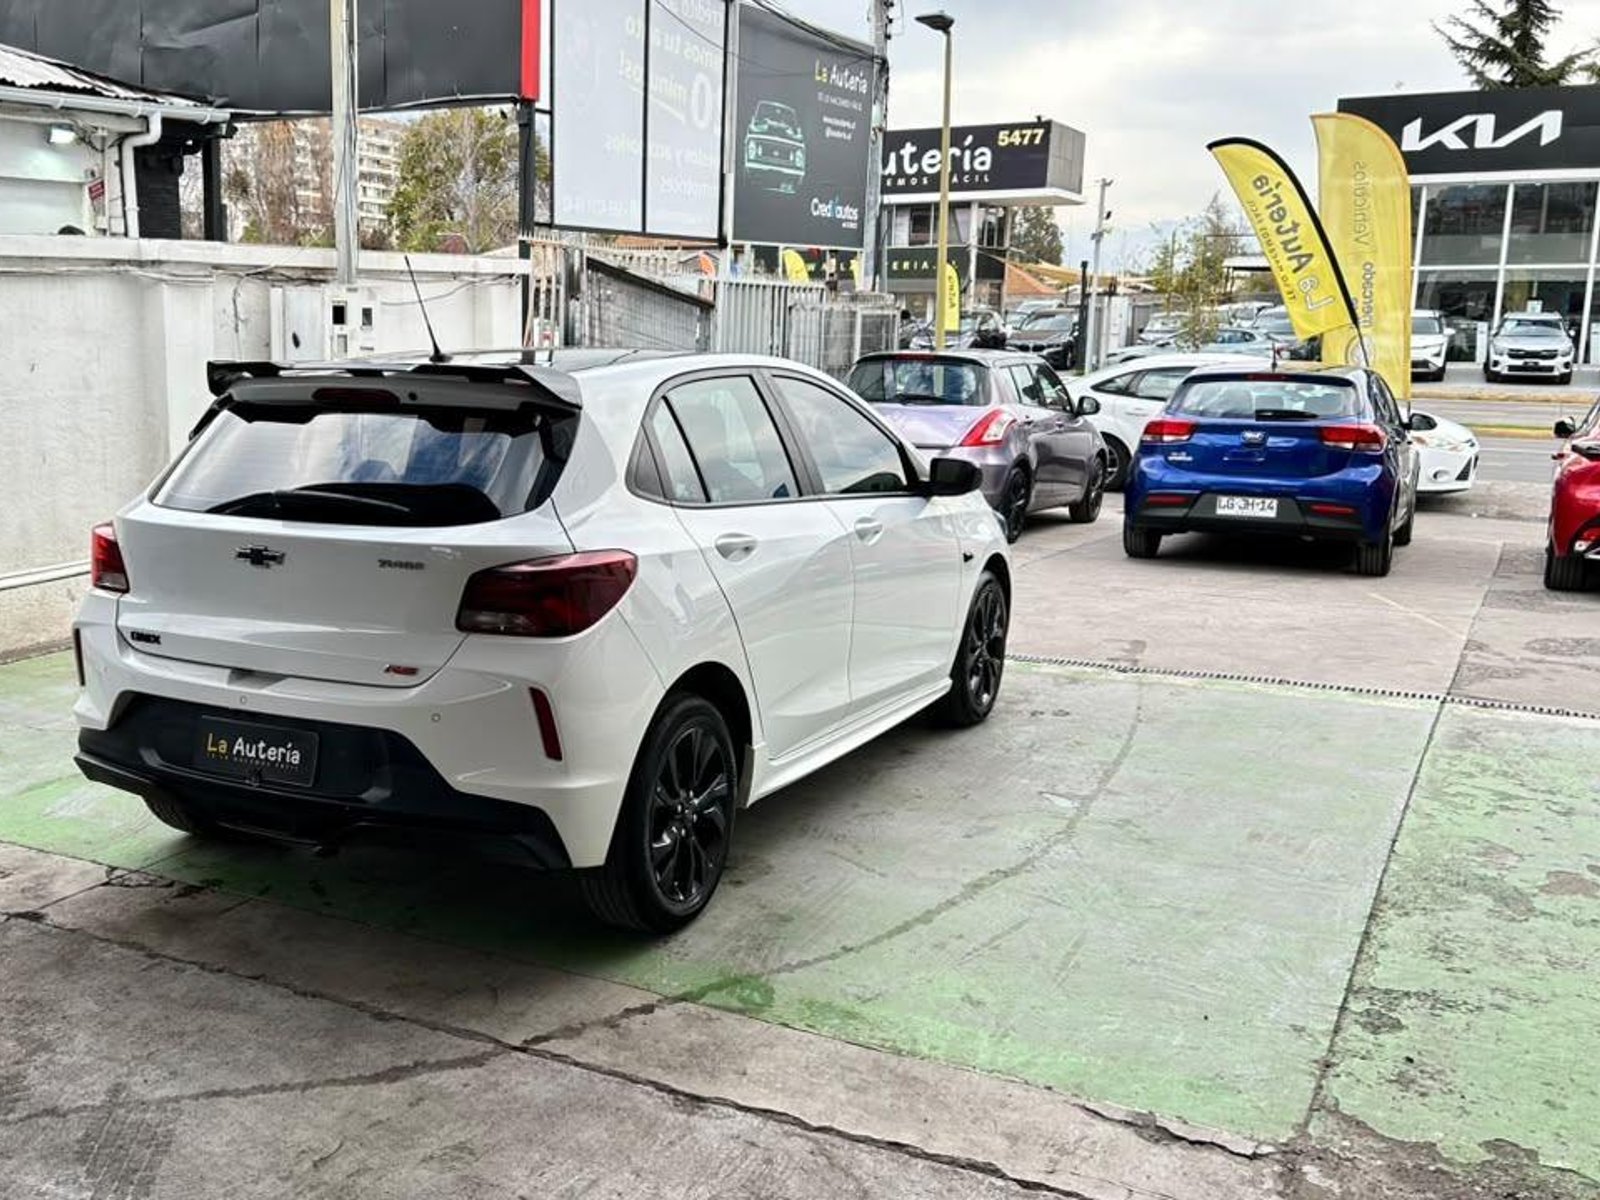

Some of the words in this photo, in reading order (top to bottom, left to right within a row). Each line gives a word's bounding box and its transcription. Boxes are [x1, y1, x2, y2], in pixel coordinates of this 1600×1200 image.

[815, 59, 828, 83] La
[996, 128, 1044, 147] 5477
[1401, 110, 1563, 152] KIA
[881, 134, 992, 176] utería
[886, 176, 929, 187] EMOS
[206, 732, 228, 754] La
[232, 736, 301, 765] Autería
